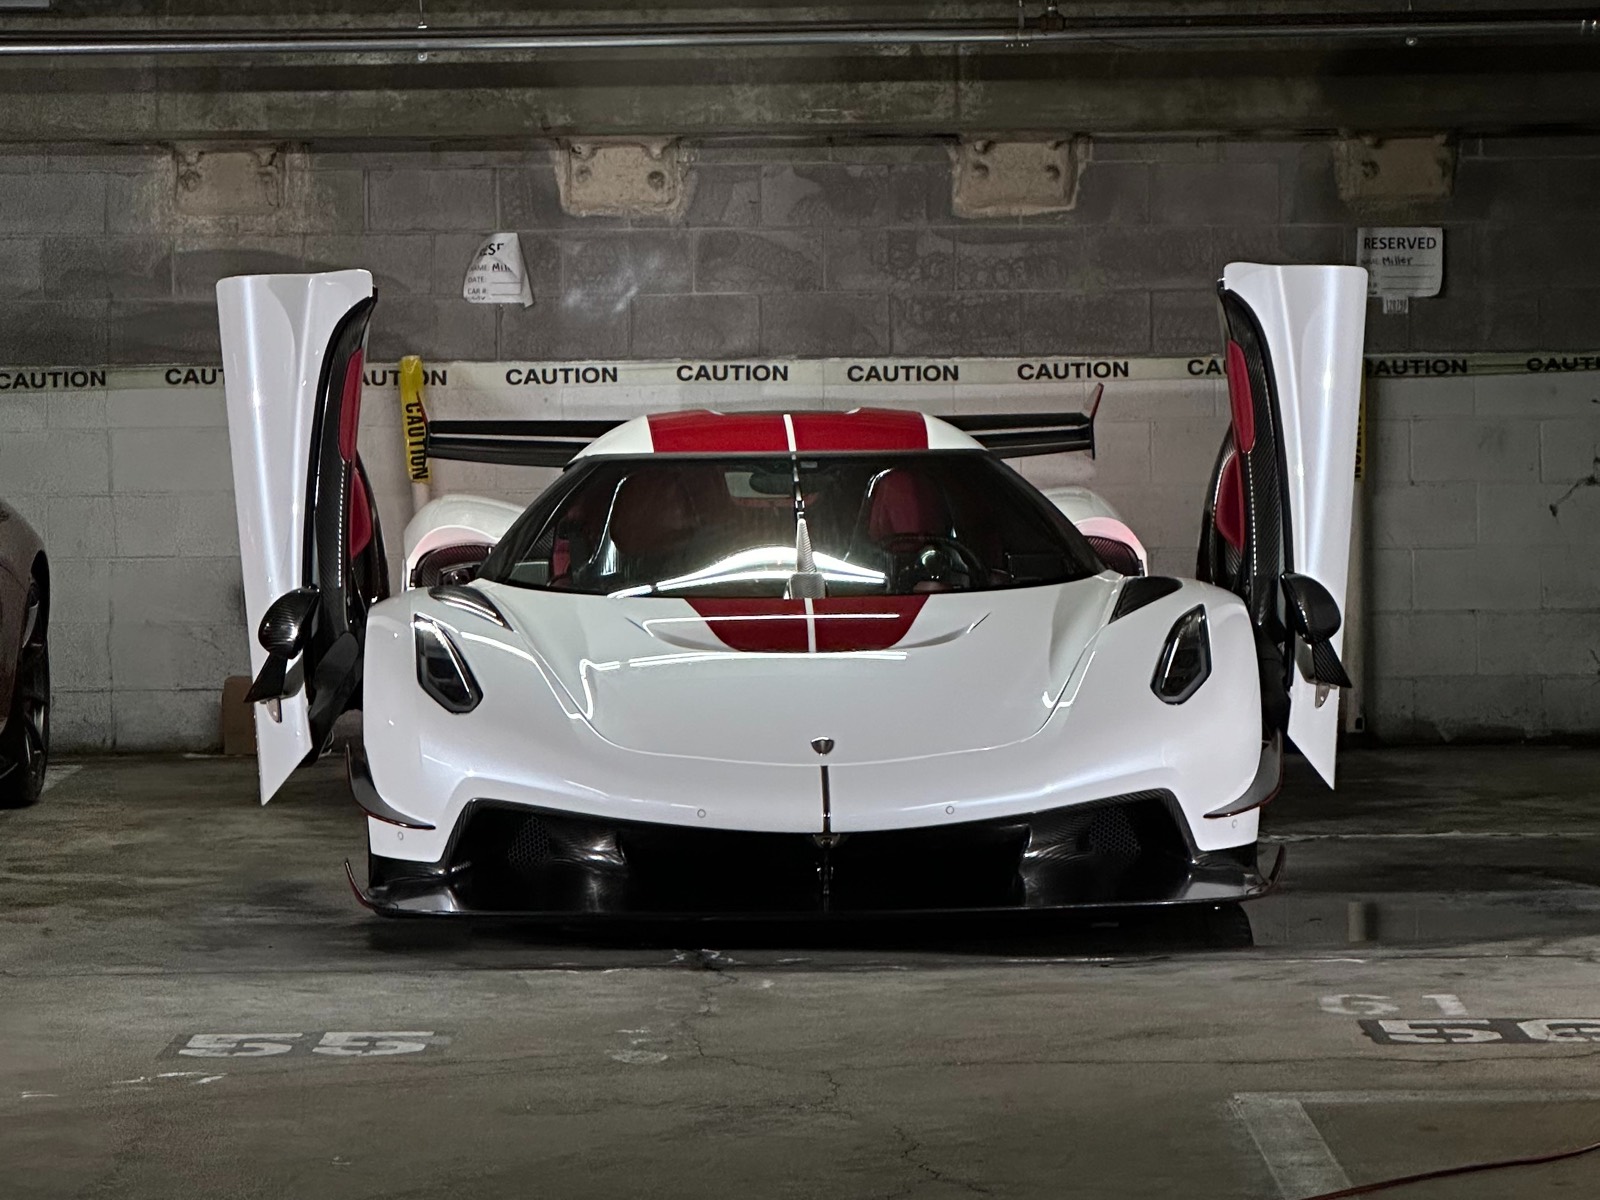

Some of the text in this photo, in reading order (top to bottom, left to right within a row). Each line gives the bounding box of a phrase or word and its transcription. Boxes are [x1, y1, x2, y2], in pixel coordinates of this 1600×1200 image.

[1364, 237, 1436, 250] RESERVED
[1382, 256, 1413, 265] Miller
[0, 370, 106, 389] CAUTION
[505, 367, 618, 385] CAUTION
[676, 365, 789, 381] CAUTION
[847, 365, 959, 382] CAUTION
[1017, 361, 1129, 380] CAUTION
[1187, 359, 1227, 376] CA
[405, 402, 429, 480] CAUTION
[178, 1030, 435, 1058] 55
